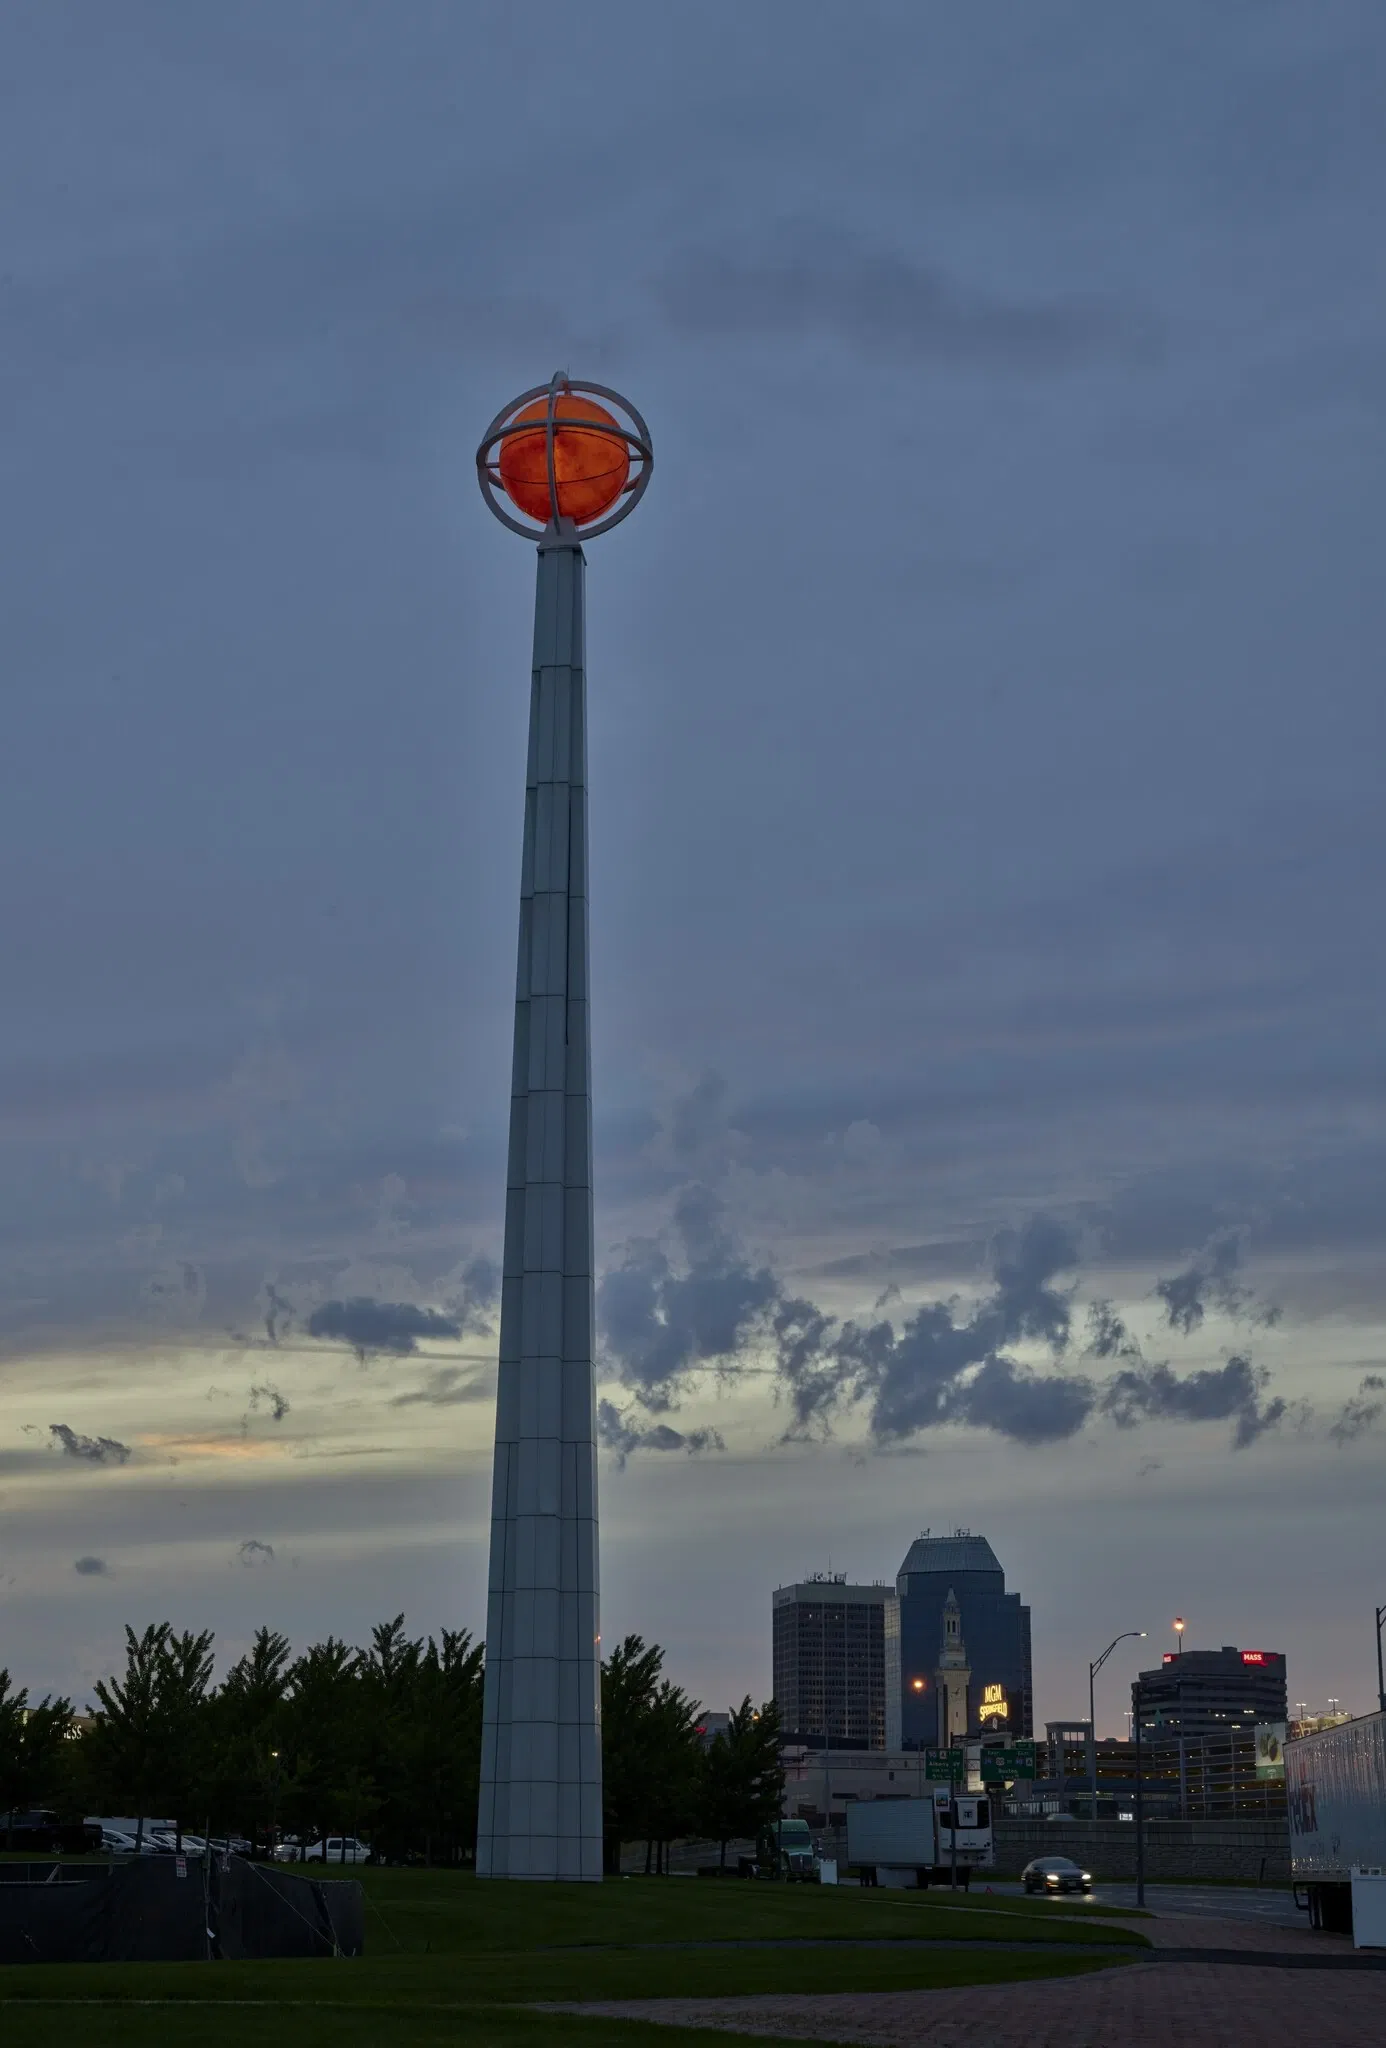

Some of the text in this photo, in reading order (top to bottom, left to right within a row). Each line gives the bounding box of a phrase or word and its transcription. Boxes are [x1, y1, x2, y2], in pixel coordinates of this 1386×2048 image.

[1243, 1653, 1262, 1661] MASS
[984, 1684, 1002, 1703] MGM
[979, 1702, 1008, 1722] SPRINGFIELD
